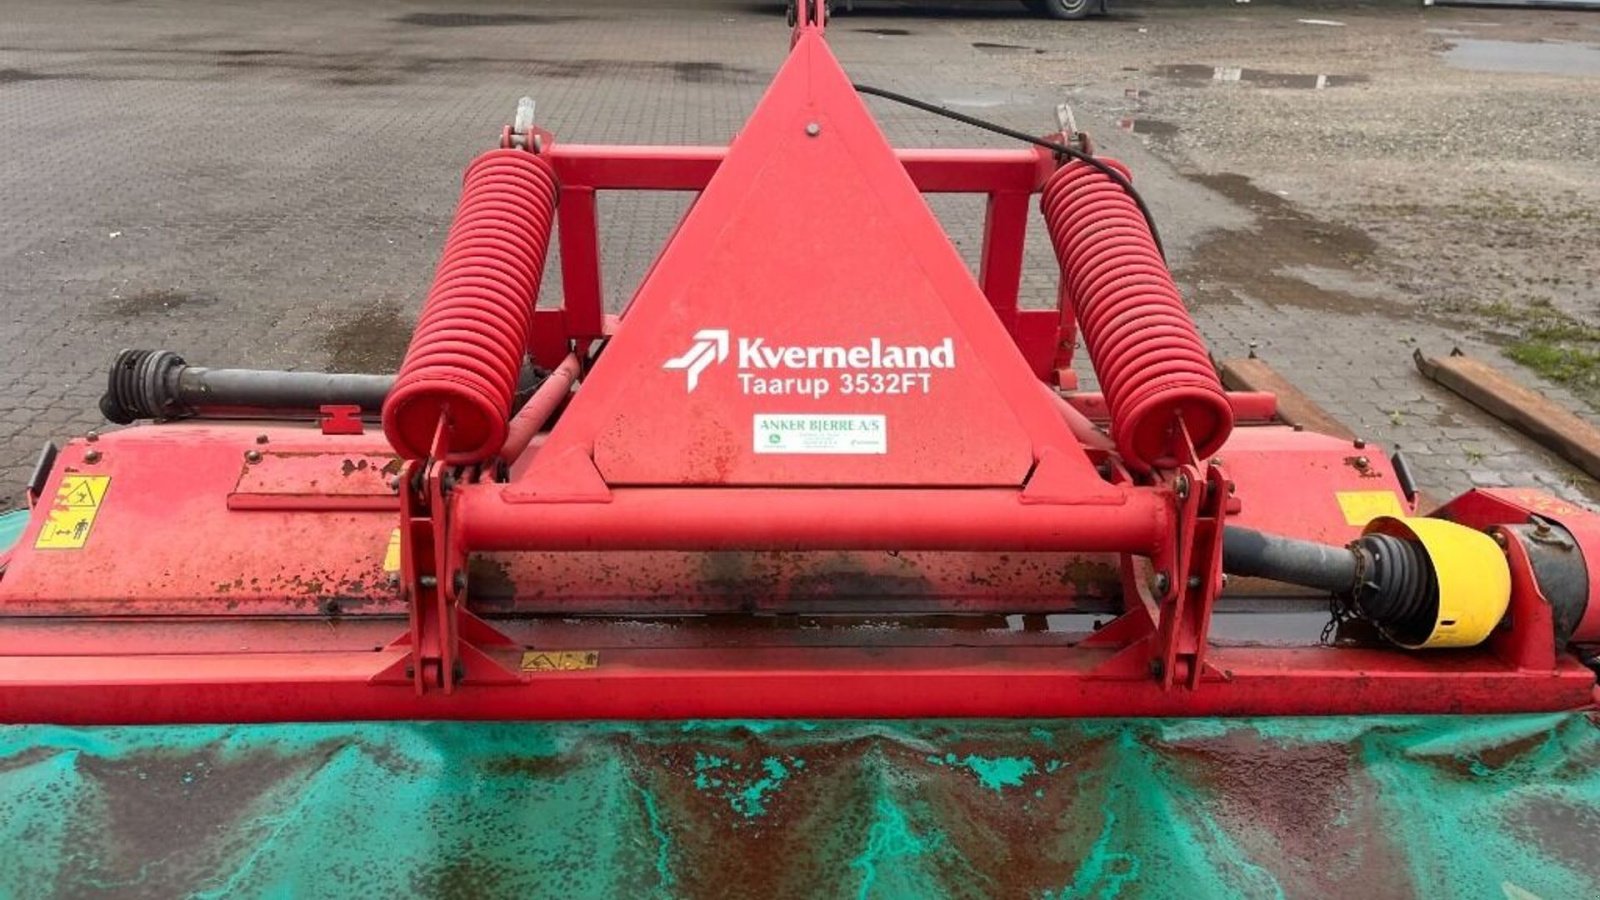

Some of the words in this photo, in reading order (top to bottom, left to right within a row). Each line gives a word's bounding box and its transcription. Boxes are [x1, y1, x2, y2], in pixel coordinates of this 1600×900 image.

[738, 337, 955, 368] Kverneland
[738, 373, 830, 398] Taarup
[840, 373, 931, 394] 3532FT
[760, 420, 805, 431] ANKER
[809, 420, 854, 432] BJERRE
